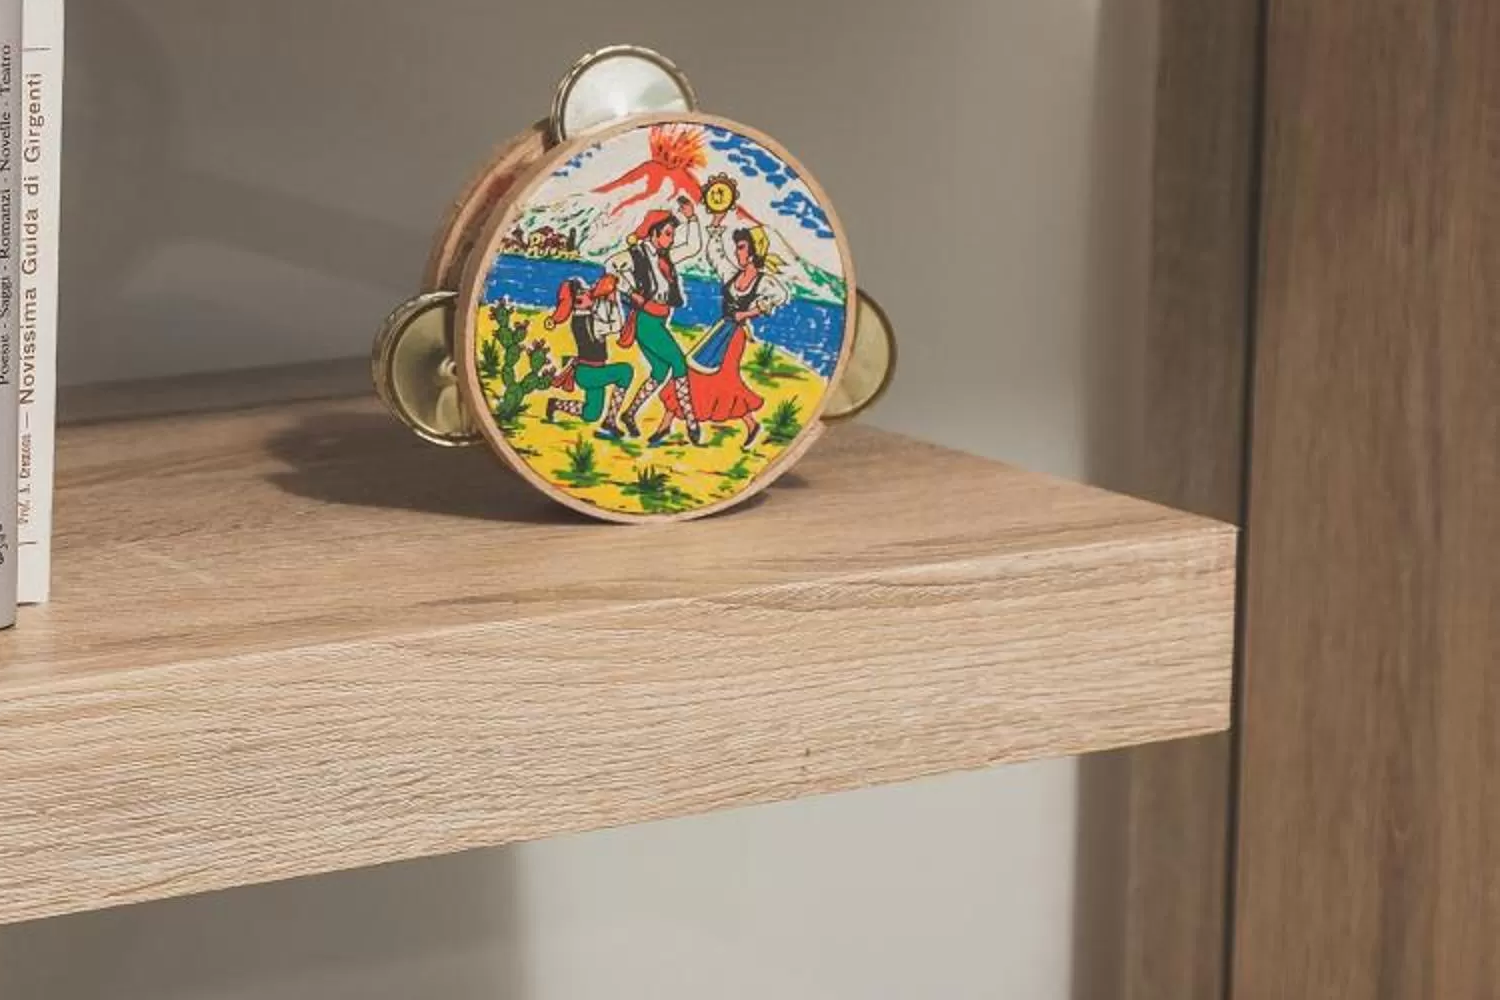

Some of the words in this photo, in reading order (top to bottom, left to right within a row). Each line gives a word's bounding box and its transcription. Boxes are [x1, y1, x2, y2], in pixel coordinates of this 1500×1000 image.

[0, 110, 12, 173] Novelle
[23, 72, 45, 163] Girgenti
[23, 176, 40, 196] di
[21, 207, 39, 275] Guida
[19, 287, 38, 405] Novissima
